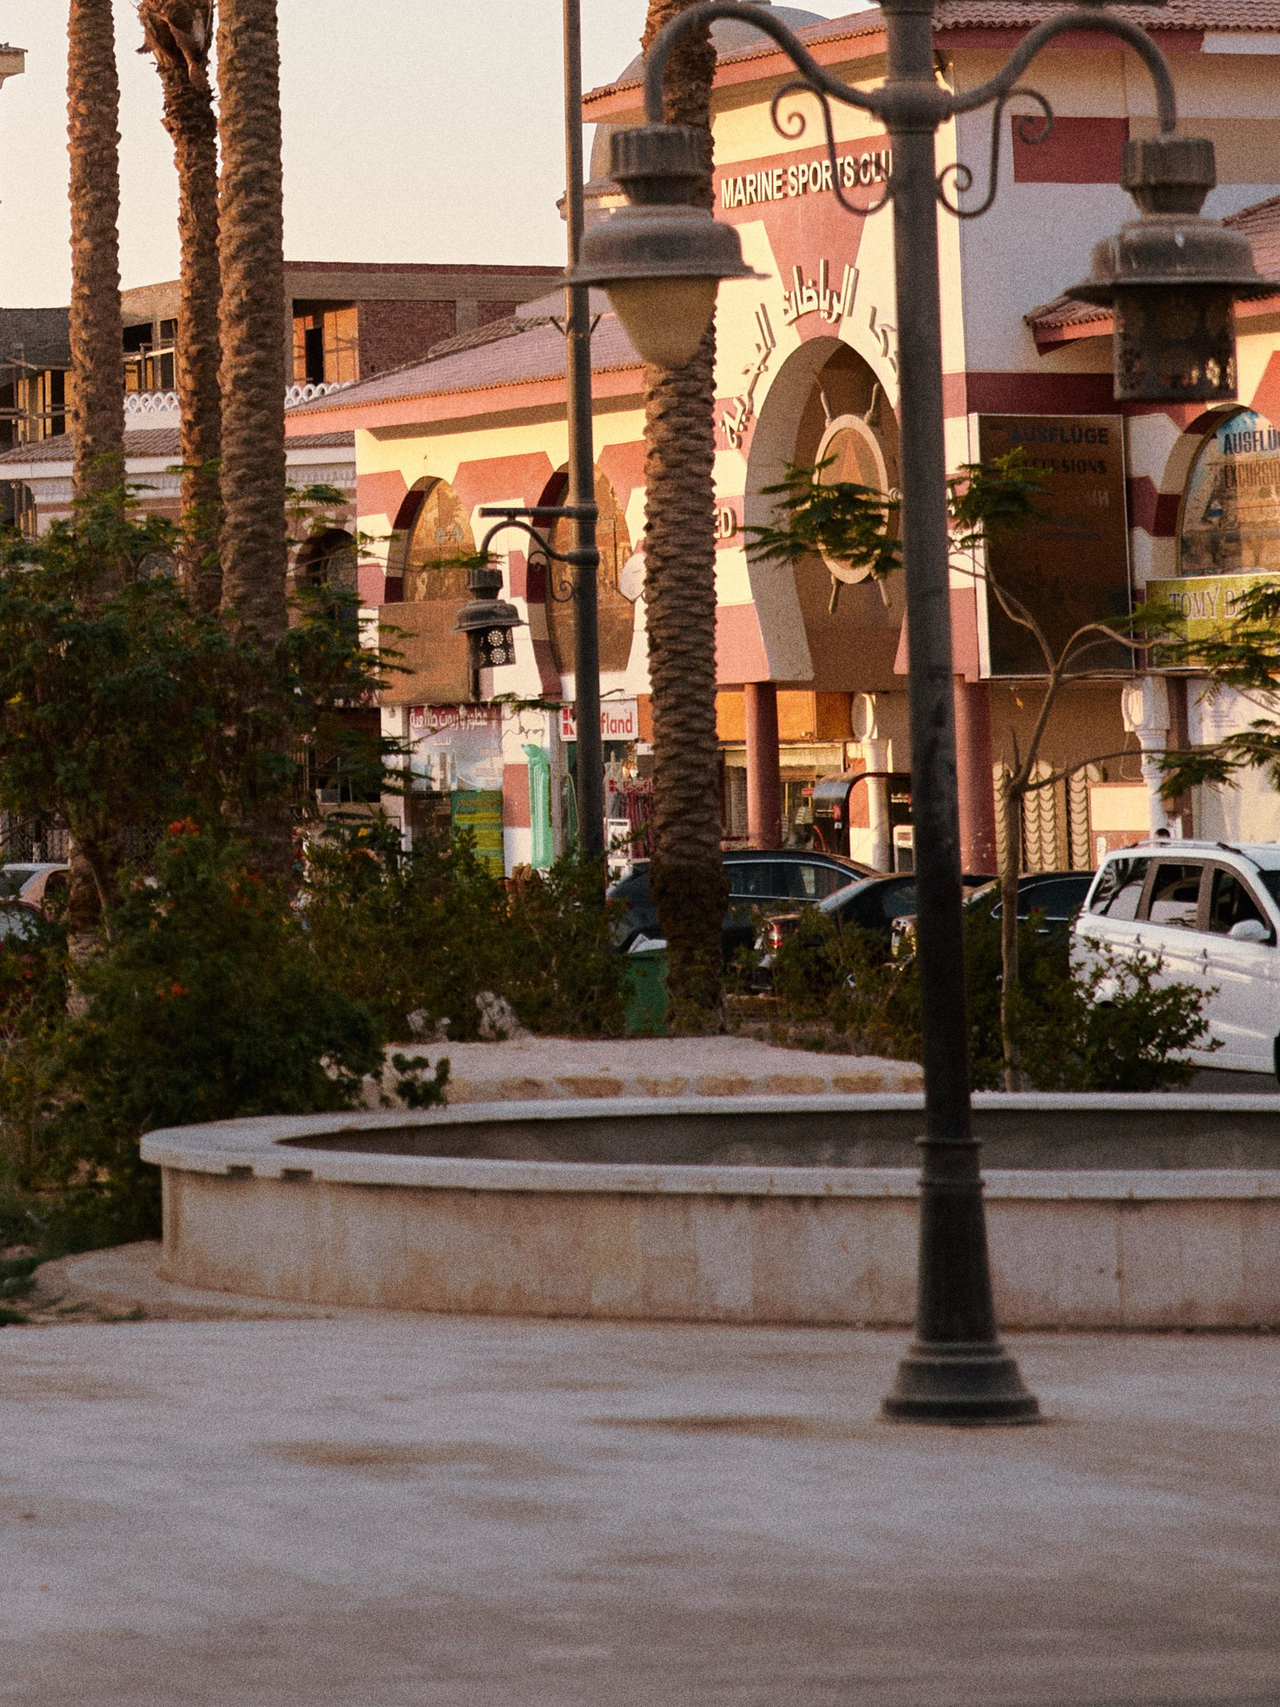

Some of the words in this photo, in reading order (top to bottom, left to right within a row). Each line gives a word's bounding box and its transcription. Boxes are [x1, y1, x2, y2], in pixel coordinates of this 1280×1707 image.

[721, 167, 784, 209] MARINE
[787, 155, 855, 197] SPORTS
[860, 149, 893, 183] CLU
[1010, 424, 1109, 444] AUSFLÜGE
[1224, 425, 1280, 455] AUSFLÜ
